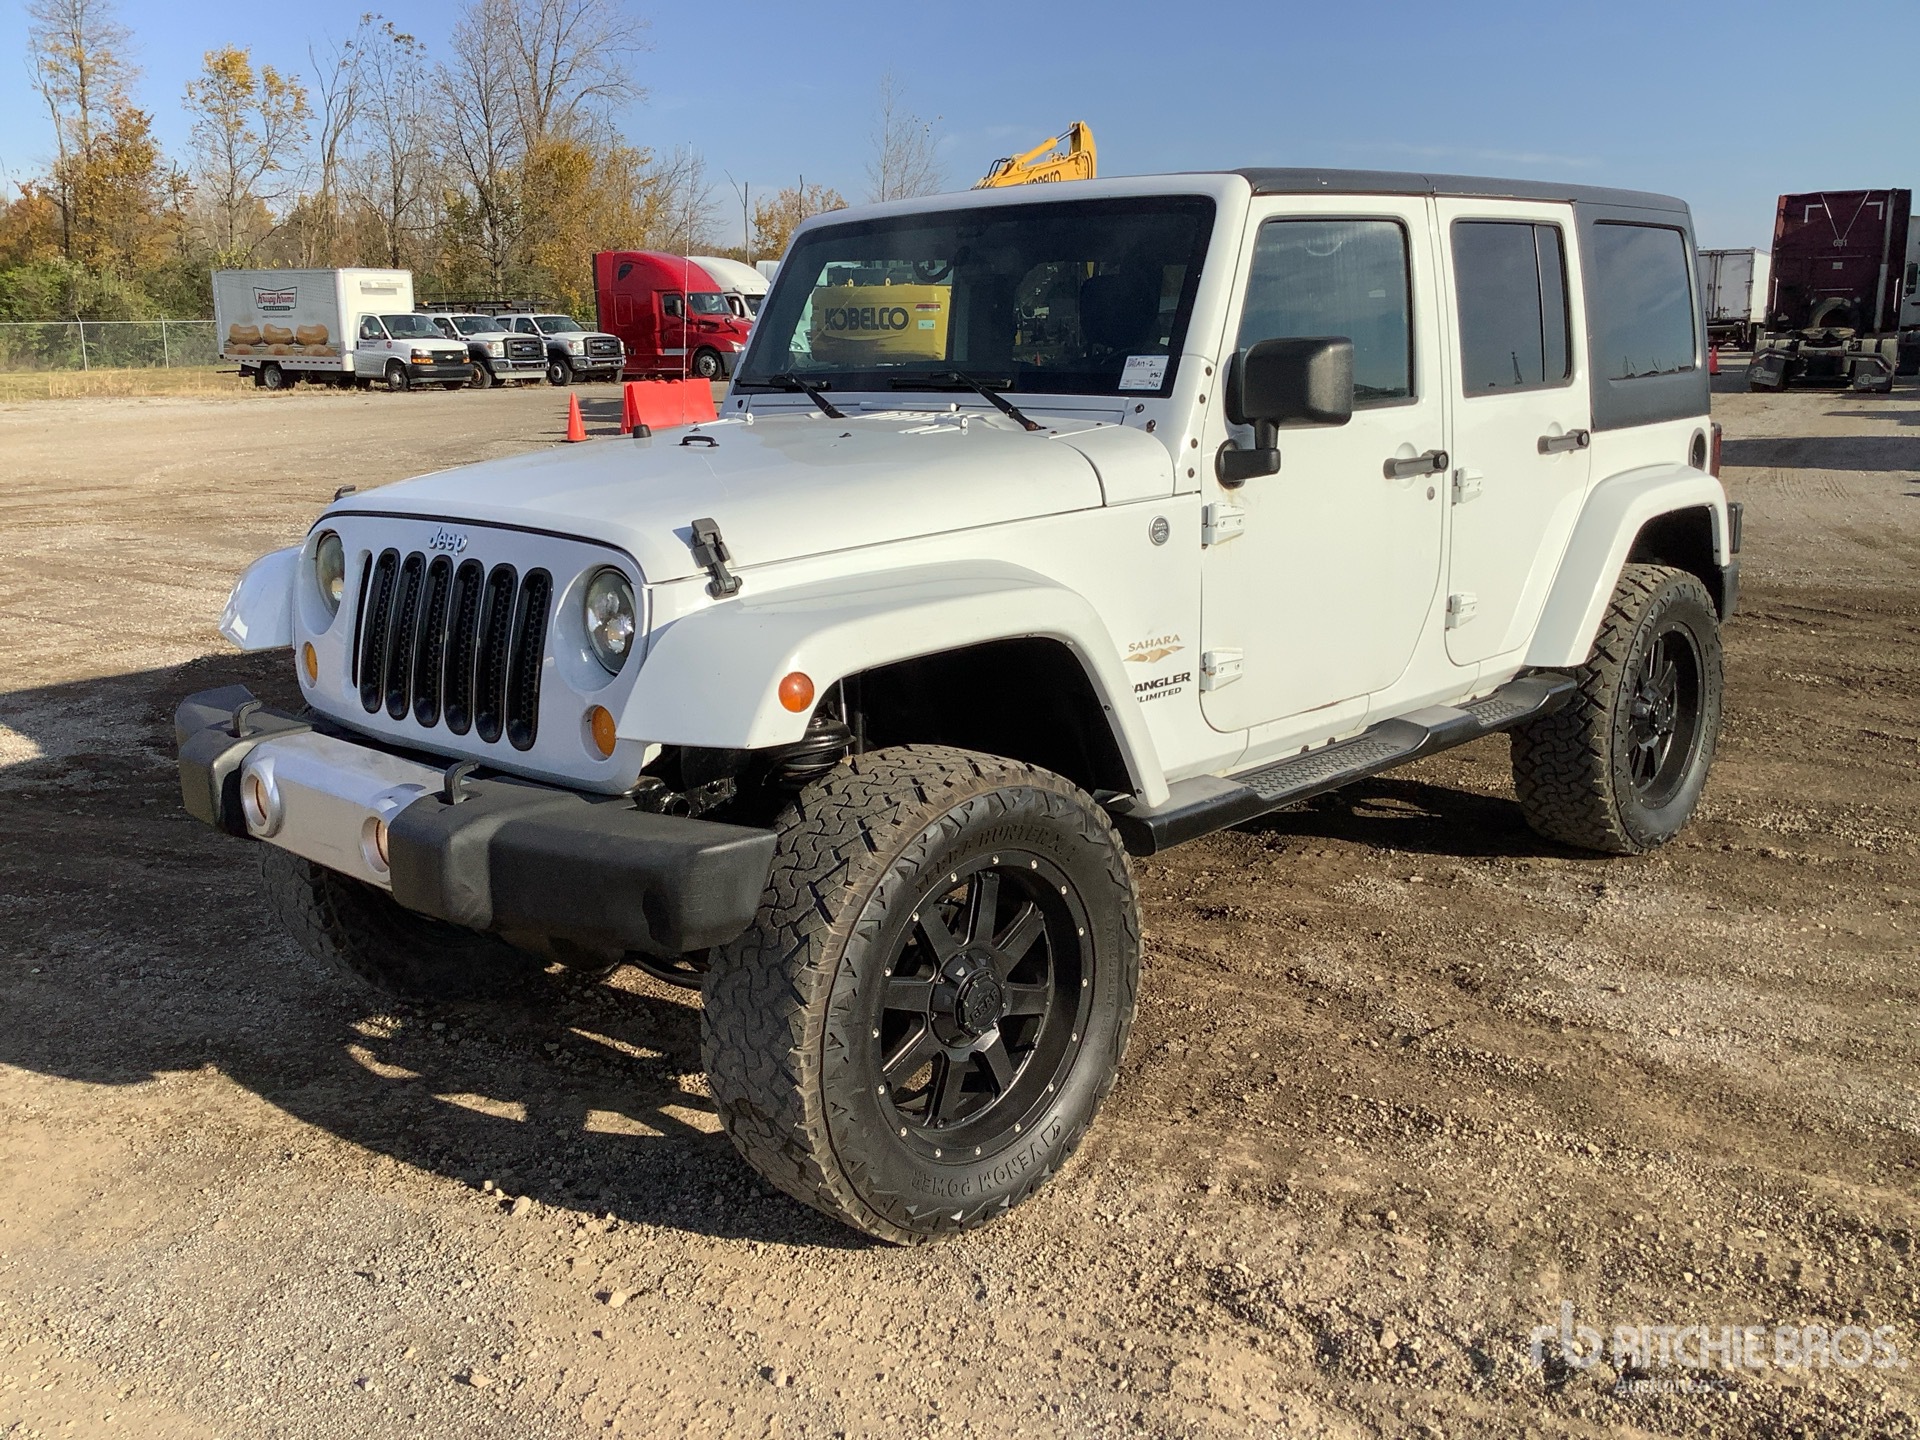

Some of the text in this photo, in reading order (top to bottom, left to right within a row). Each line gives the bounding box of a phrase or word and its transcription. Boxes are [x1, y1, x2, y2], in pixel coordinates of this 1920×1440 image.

[1026, 169, 1061, 184] BELCO
[824, 307, 909, 330] KOBELCO
[428, 526, 468, 556] Jeep
[1128, 633, 1181, 652] SAHARA
[1132, 671, 1192, 693] ANGLER
[1137, 687, 1182, 703] LIMITED
[911, 1142, 1042, 1197] VENOM POWER
